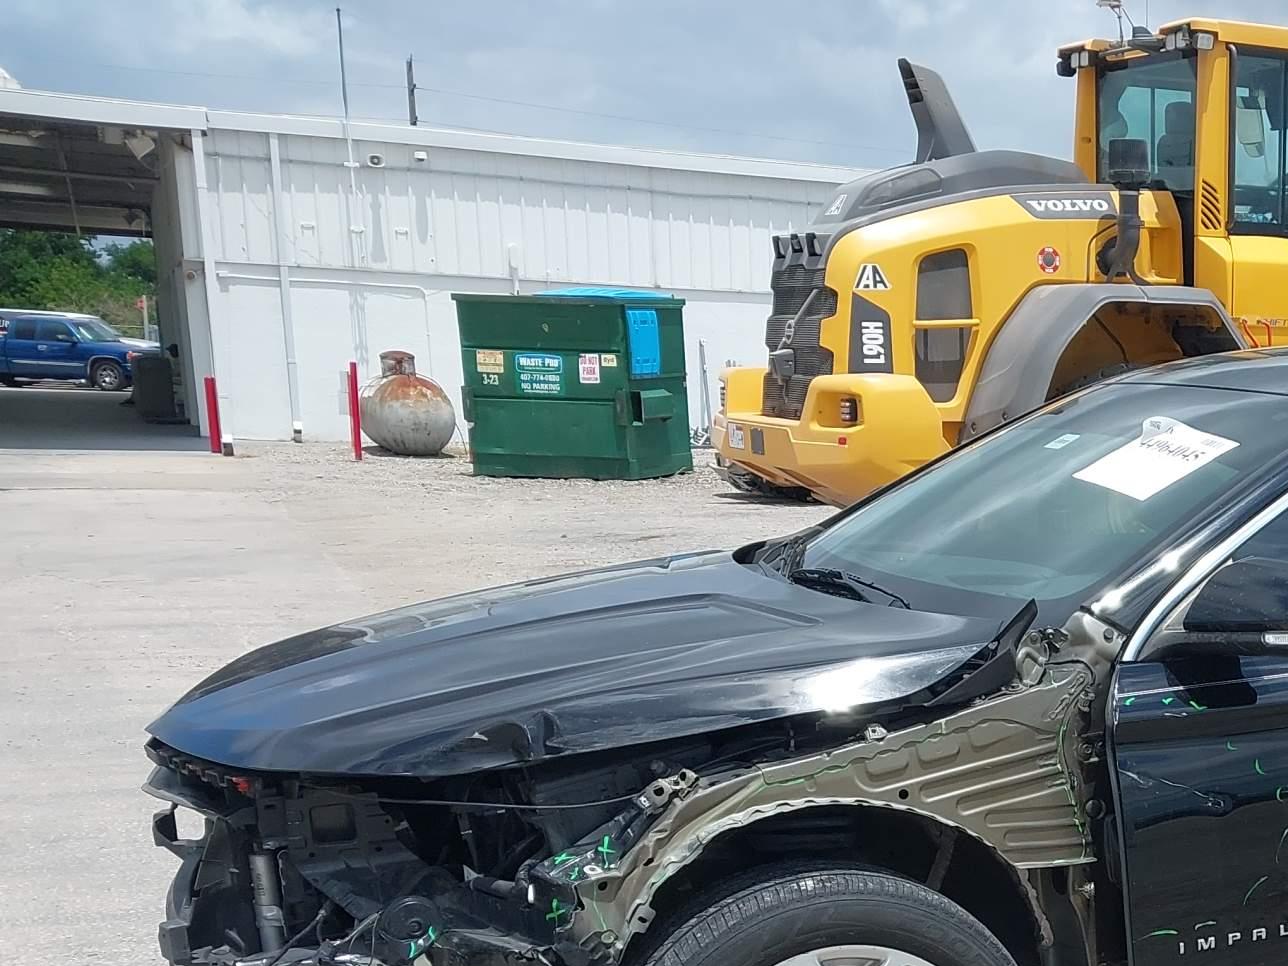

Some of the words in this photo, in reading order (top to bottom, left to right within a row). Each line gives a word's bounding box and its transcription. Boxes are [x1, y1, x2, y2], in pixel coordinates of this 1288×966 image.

[1026, 199, 1109, 211] VOLVO
[861, 321, 885, 364] L90H
[519, 357, 542, 367] WASTE
[482, 373, 499, 385] 3-23
[532, 382, 561, 391] PARKING
